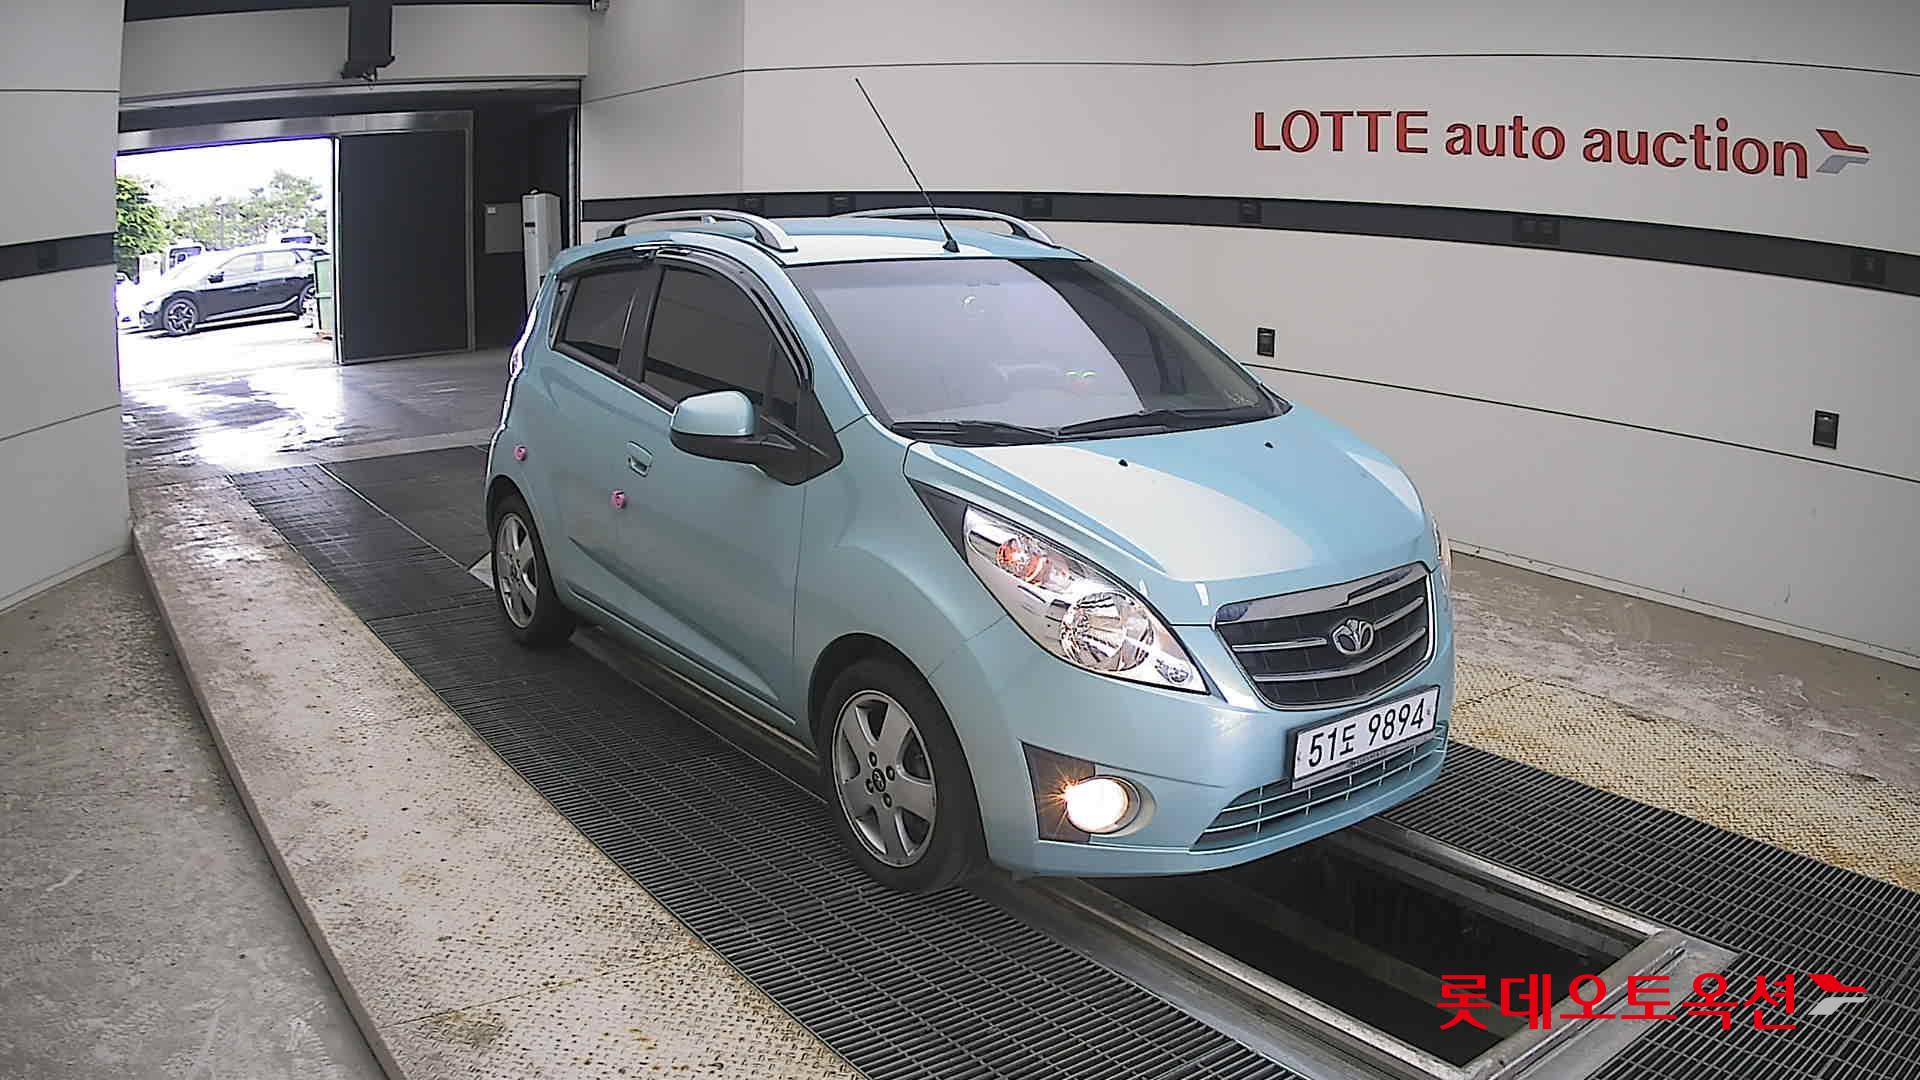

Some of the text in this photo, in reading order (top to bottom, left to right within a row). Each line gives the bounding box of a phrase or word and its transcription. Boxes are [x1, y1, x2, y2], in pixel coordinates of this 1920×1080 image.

[1255, 110, 1808, 179] LOTTE auto auction
[1308, 698, 1425, 767] 51도 9894
